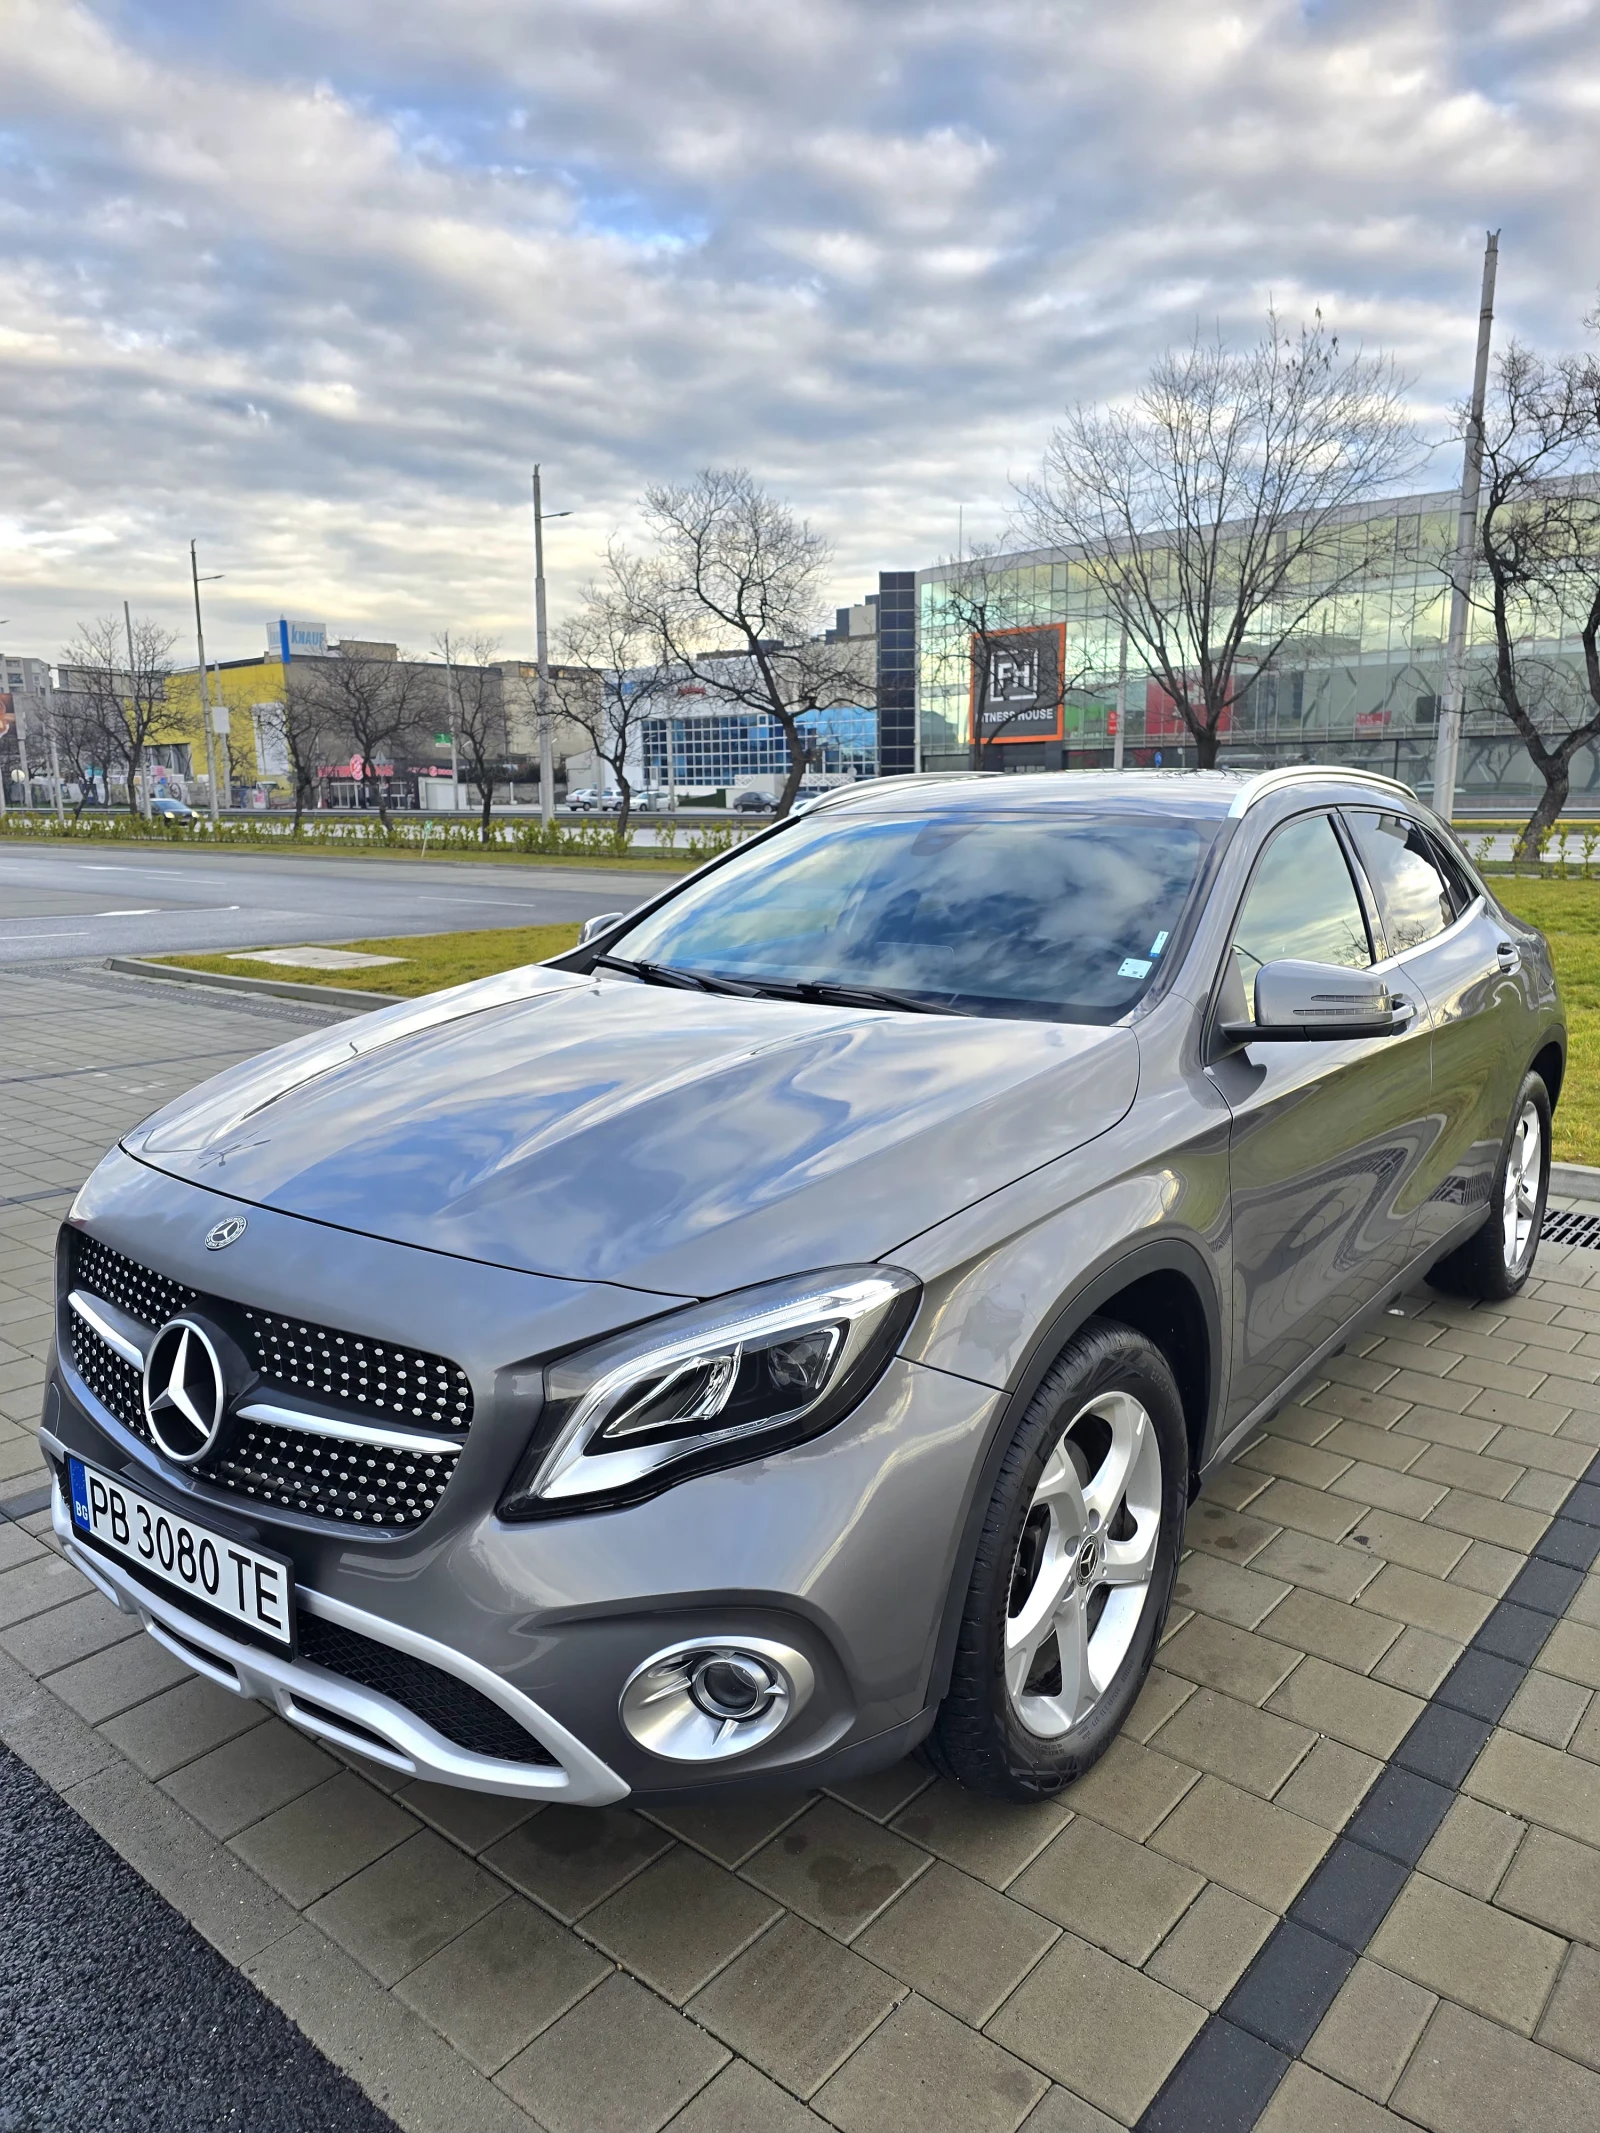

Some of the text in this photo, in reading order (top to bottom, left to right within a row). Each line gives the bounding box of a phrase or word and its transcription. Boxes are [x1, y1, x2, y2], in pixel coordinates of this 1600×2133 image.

[1017, 708, 1054, 721] HOUSE
[75, 1501, 88, 1521] BG
[89, 1476, 282, 1630] PB 3080 TE
